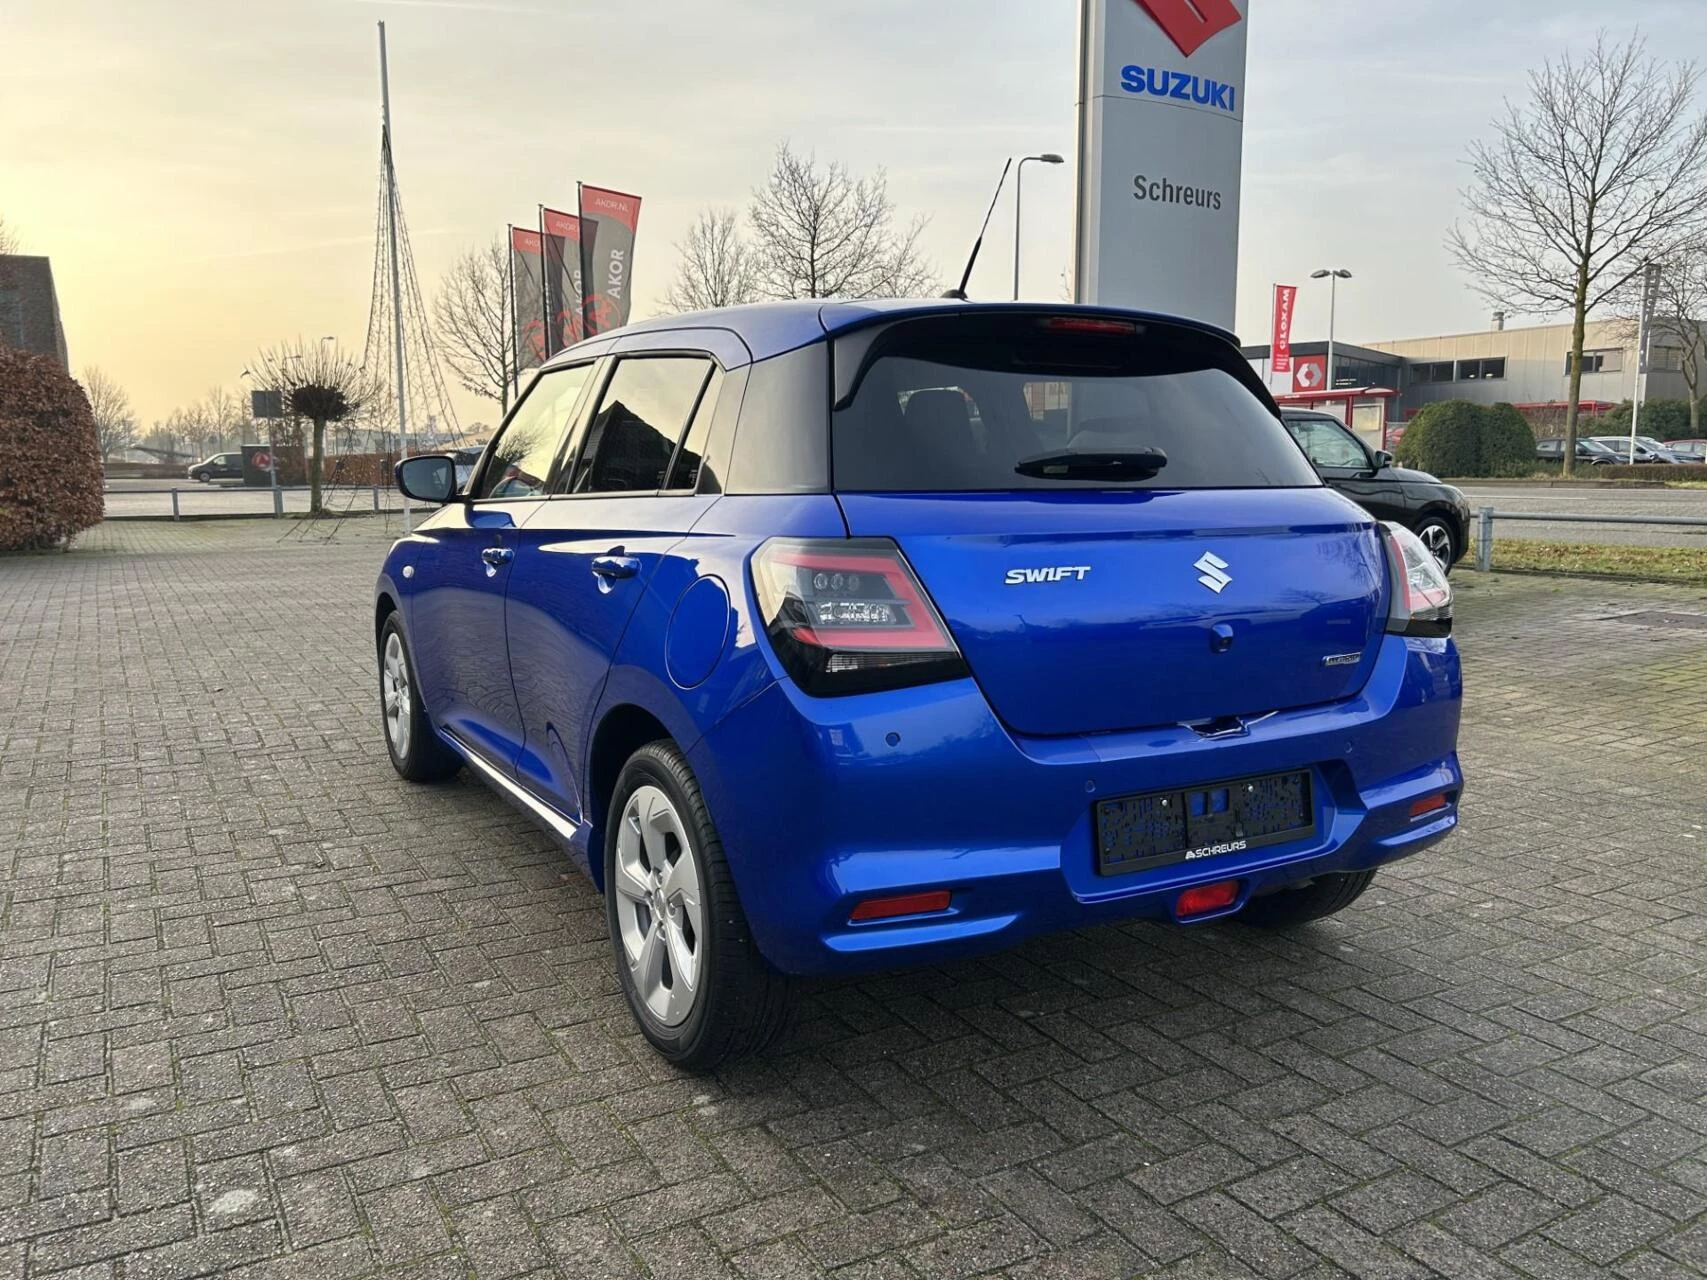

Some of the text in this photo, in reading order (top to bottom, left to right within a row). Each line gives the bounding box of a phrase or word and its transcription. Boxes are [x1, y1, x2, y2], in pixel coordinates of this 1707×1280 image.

[1120, 65, 1235, 112] SUZUKI
[1133, 174, 1221, 210] Schreurs
[607, 249, 624, 299] AKOR
[1004, 566, 1091, 585] SWIFT
[1196, 840, 1247, 857] SCHREURS
